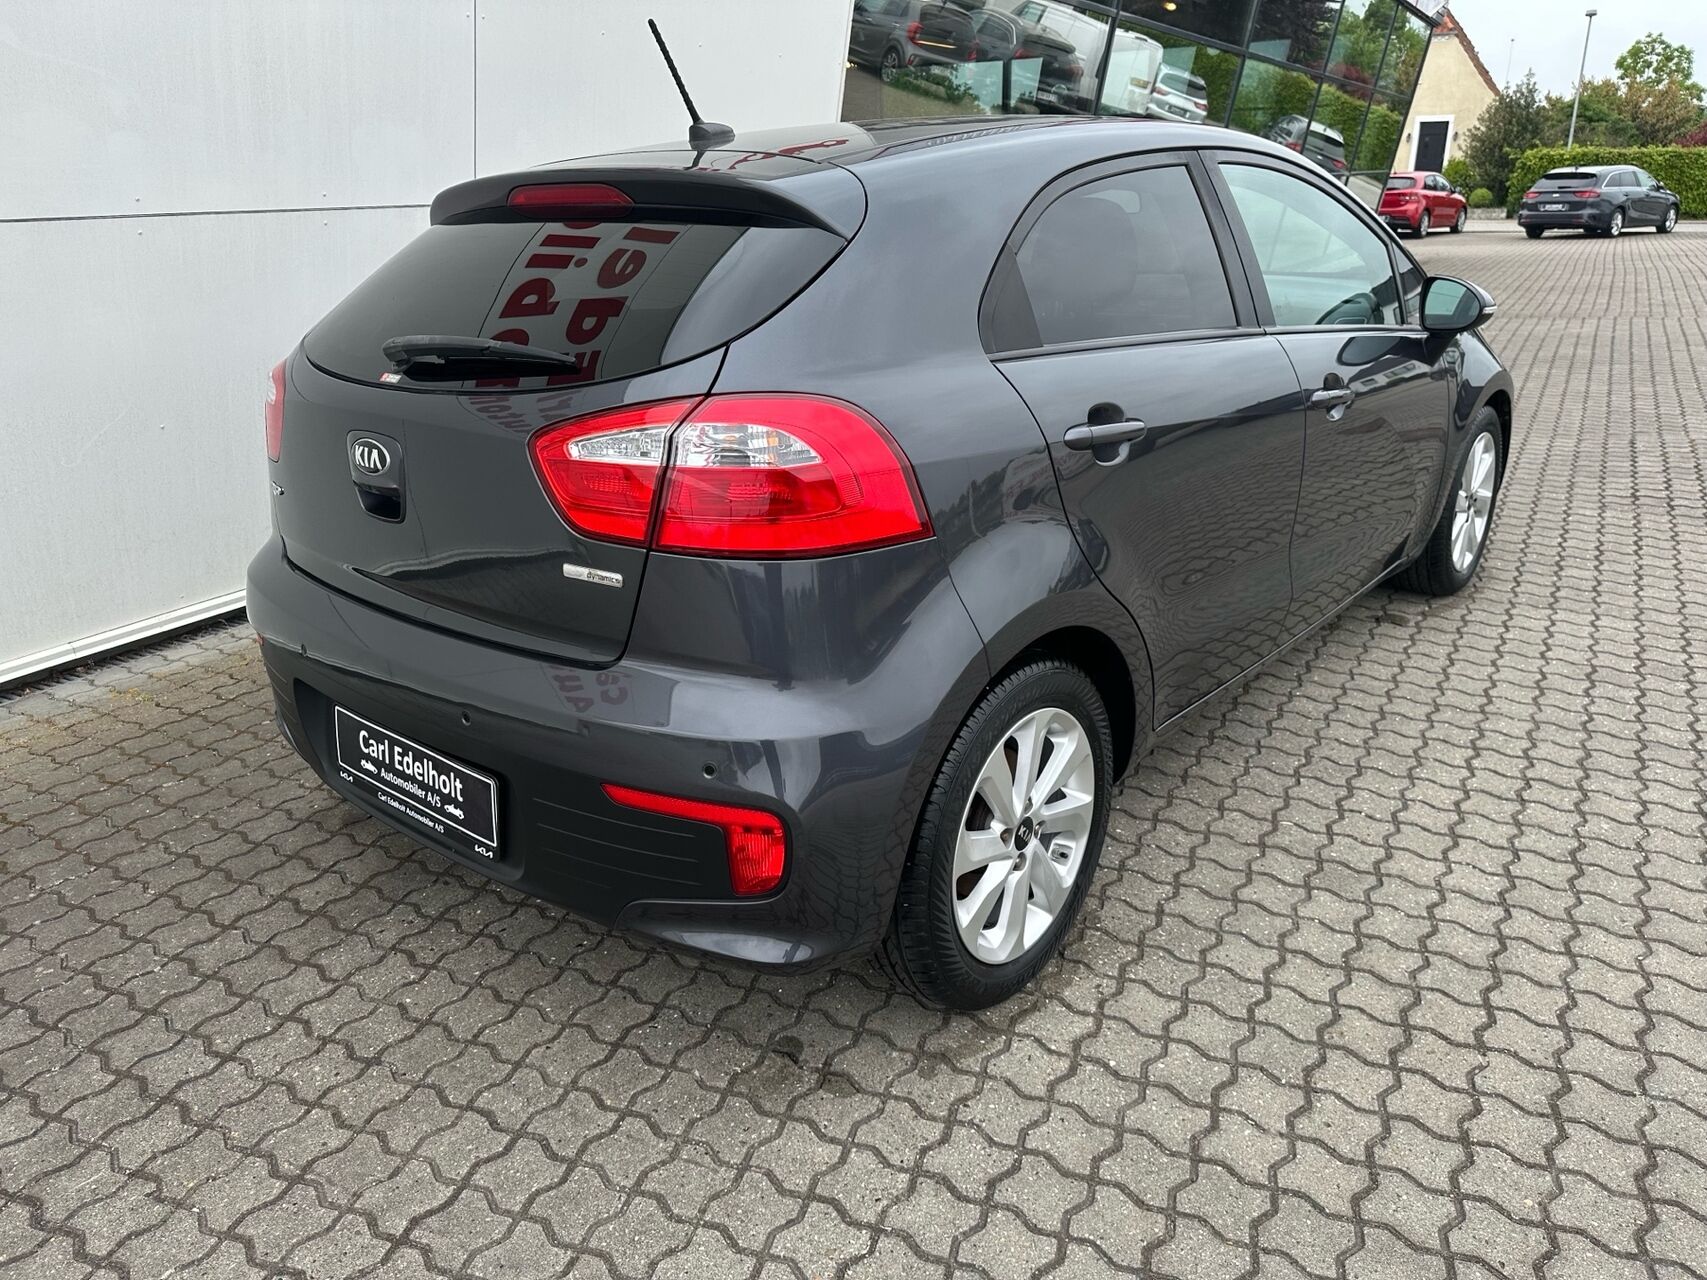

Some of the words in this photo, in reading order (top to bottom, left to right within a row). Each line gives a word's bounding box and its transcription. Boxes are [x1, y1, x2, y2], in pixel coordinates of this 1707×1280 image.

[355, 444, 383, 470] KIA
[359, 730, 389, 765] Carl
[394, 745, 463, 802] Edelholt
[380, 767, 426, 799] Automobiler
[427, 791, 441, 808] A/S
[377, 791, 388, 803] Carl
[387, 796, 406, 812] Edelholt
[405, 807, 435, 830] Automobiler
[434, 822, 445, 834] A/S
[1018, 824, 1032, 842] KIA
